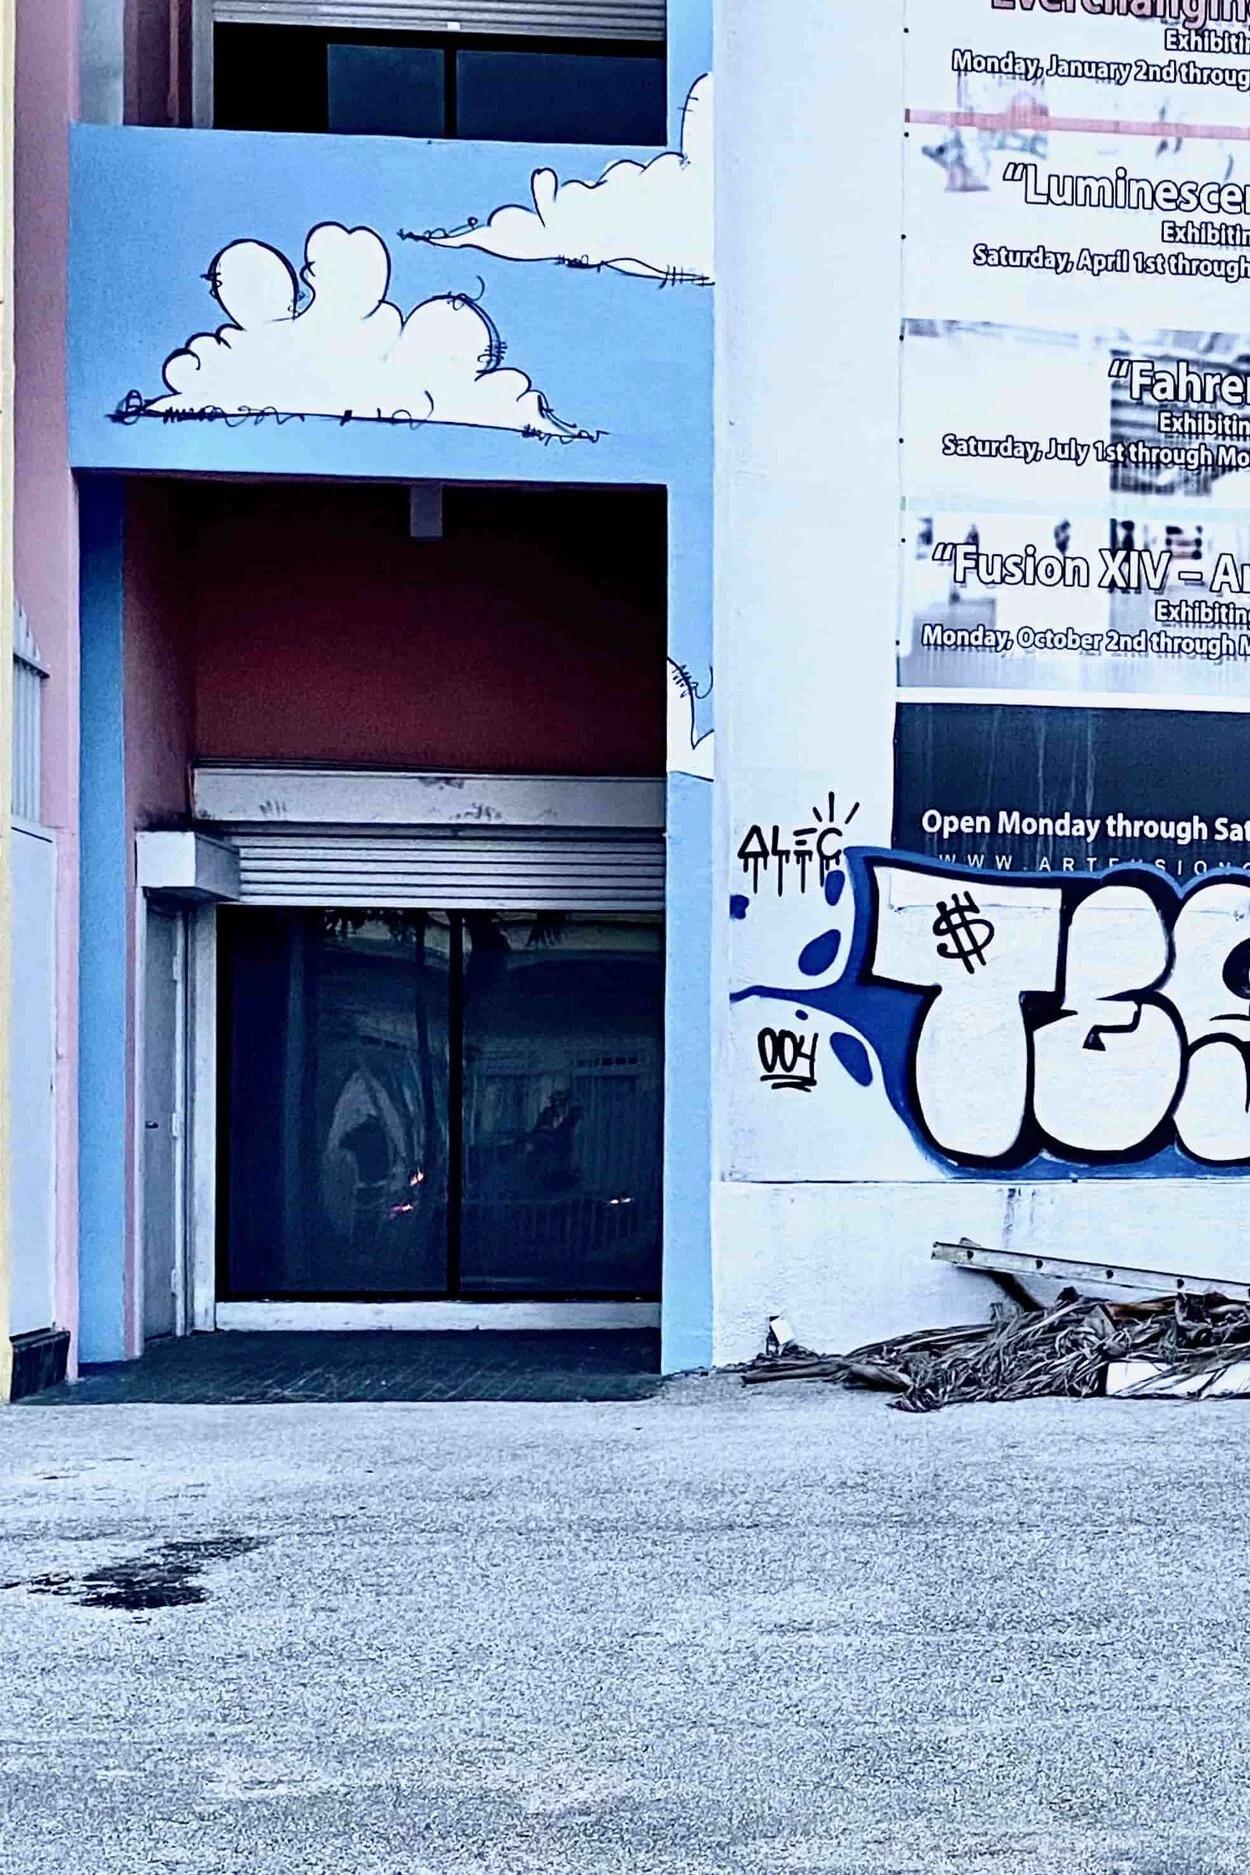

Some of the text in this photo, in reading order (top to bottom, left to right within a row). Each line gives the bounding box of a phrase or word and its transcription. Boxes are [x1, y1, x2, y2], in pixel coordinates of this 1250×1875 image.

[952, 50, 1043, 81] Monday,
[1046, 54, 1132, 85] January
[1134, 60, 1176, 83] 2nd
[973, 243, 1074, 274] Saturday,
[1077, 249, 1129, 275] April
[1134, 252, 1165, 274] 1st
[942, 434, 1043, 464] Saturday,
[1045, 437, 1091, 466] July
[1093, 441, 1126, 463] 1st
[1128, 442, 1213, 471] through
[932, 542, 1090, 587] “Fusion
[1098, 548, 1172, 590] XIV
[922, 624, 1013, 652] Monday,
[1016, 625, 1102, 651] October
[1105, 629, 1147, 653] 2nd
[1149, 630, 1235, 660] through
[922, 809, 990, 839] Open
[997, 810, 1100, 843] Monday
[1106, 813, 1207, 845] through
[737, 824, 844, 888] ALEC
